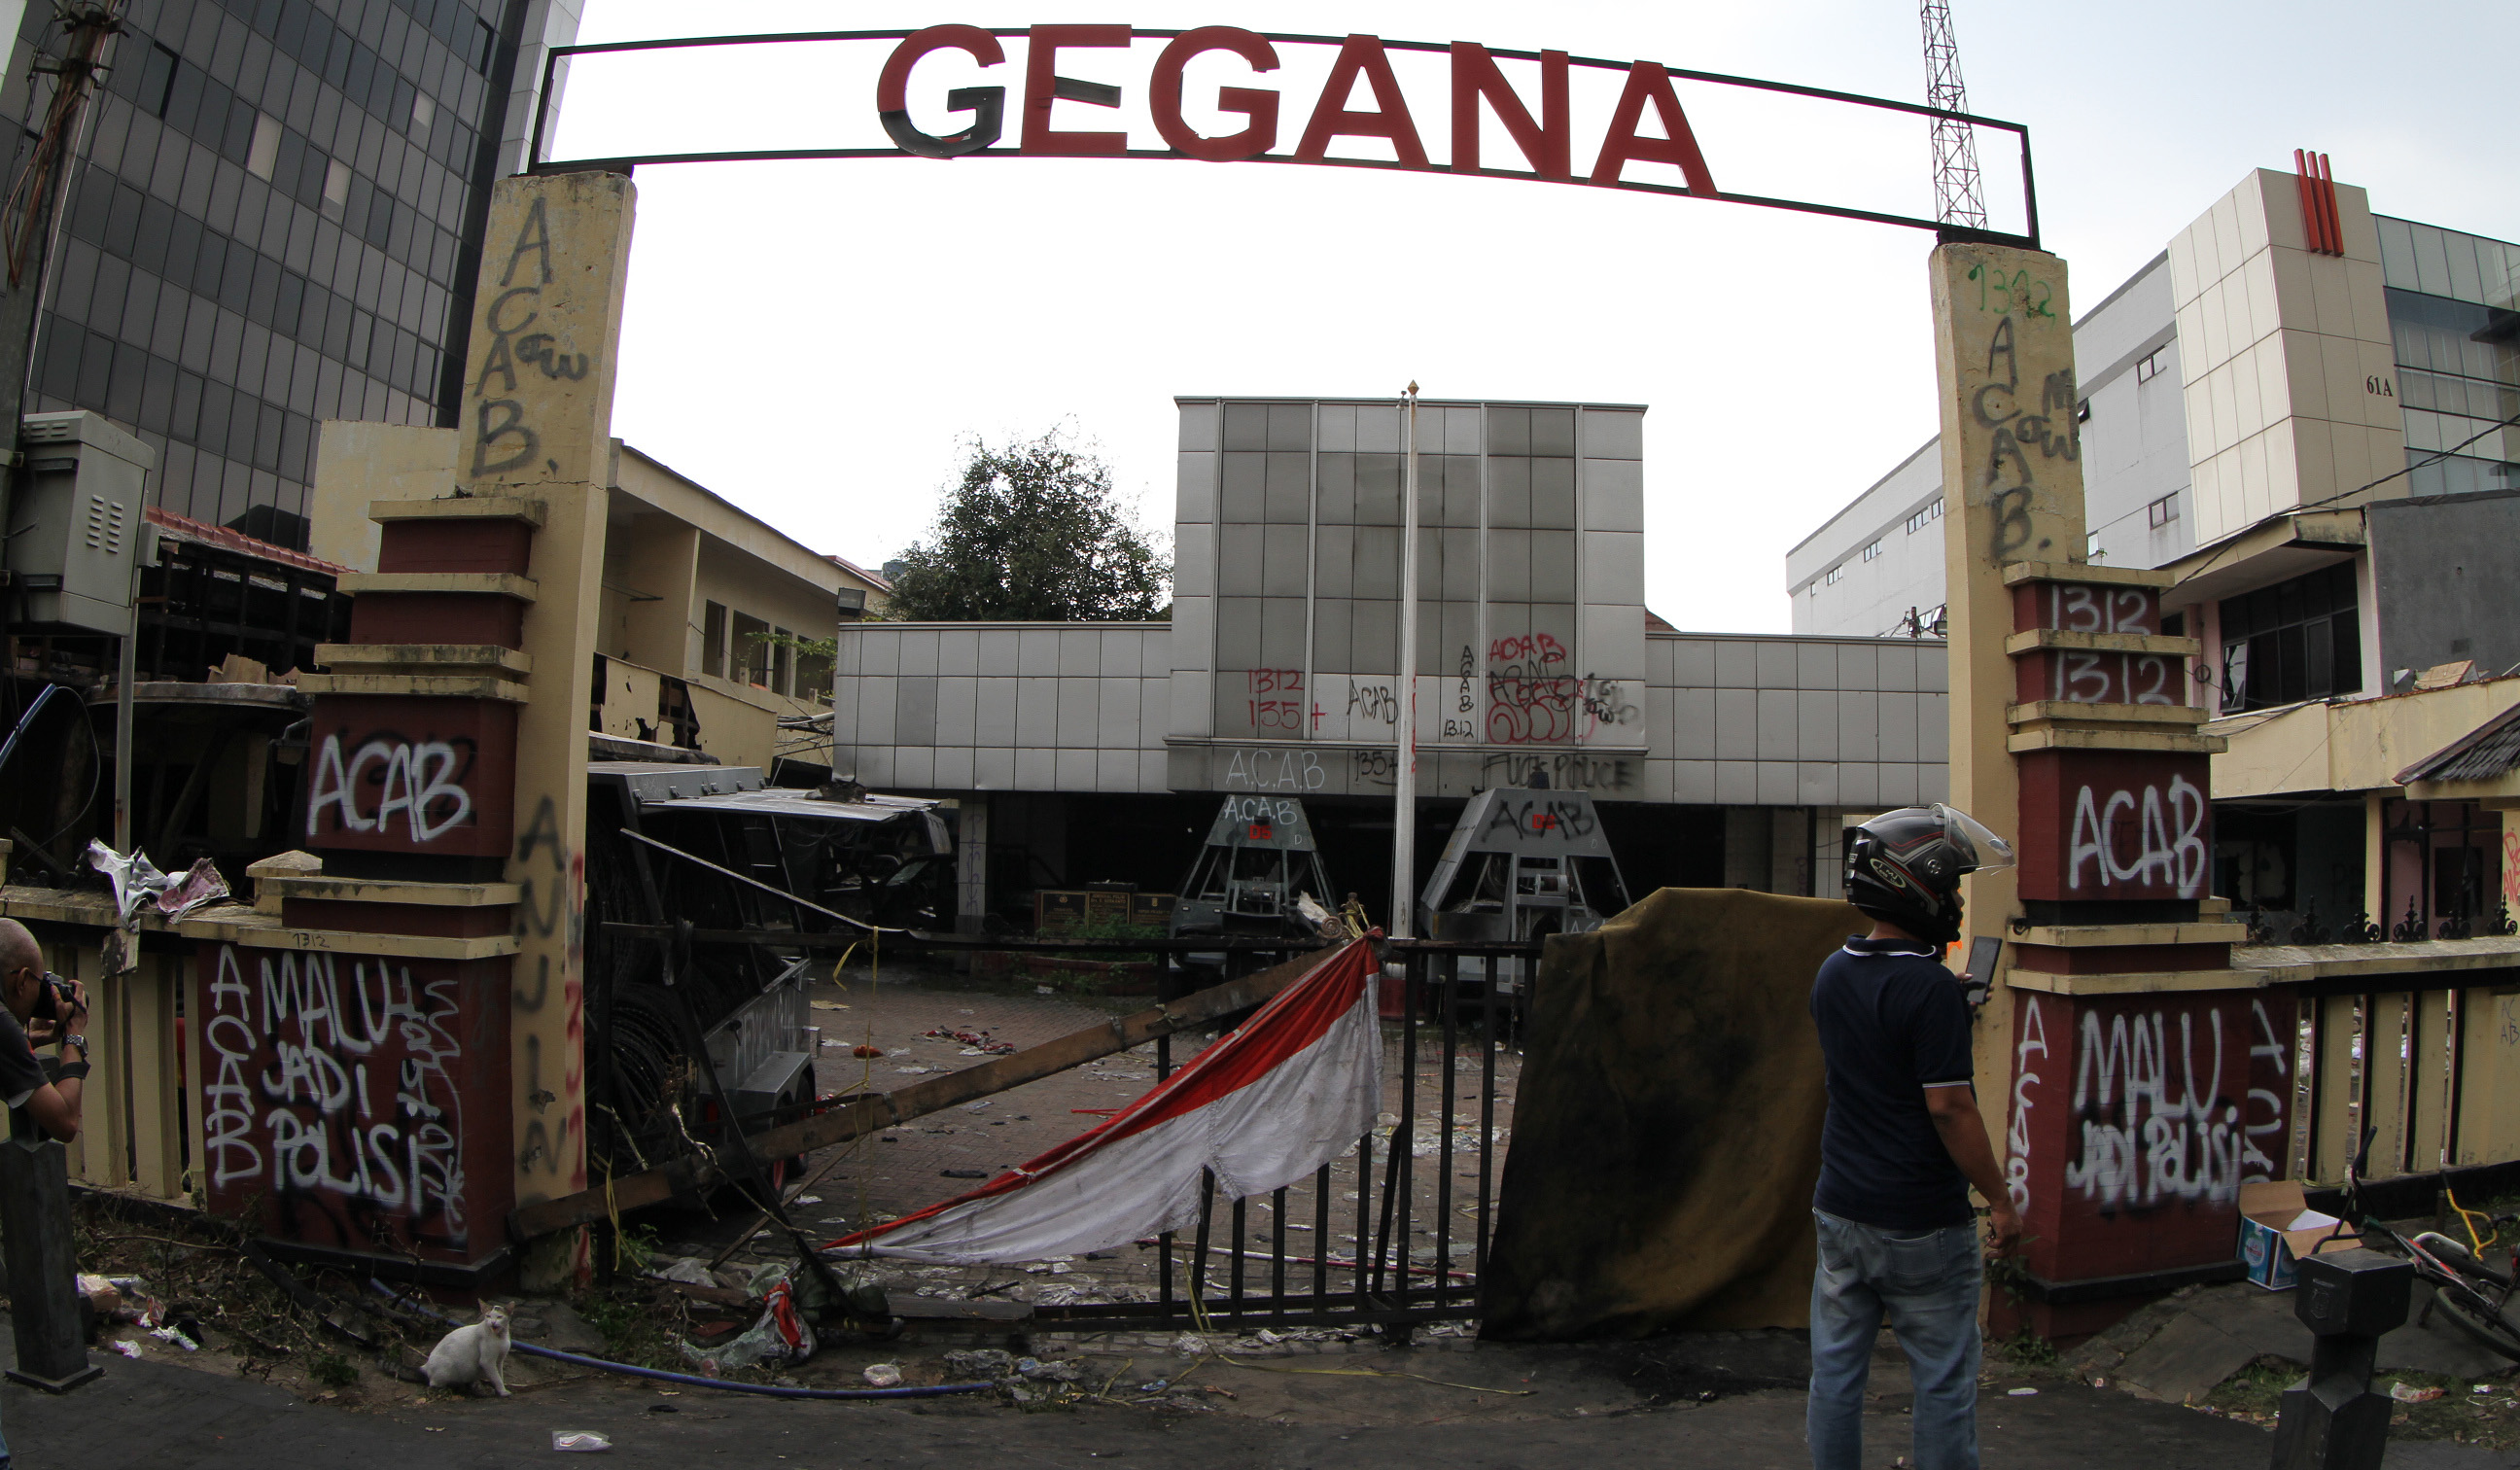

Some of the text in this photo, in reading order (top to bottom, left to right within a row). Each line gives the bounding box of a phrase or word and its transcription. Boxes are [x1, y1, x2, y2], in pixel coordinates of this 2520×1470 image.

[877, 23, 1719, 197] GEGANA
[1969, 264, 2055, 327] 1312
[2365, 374, 2395, 398] 61A
[2051, 583, 2152, 635] 1312
[1248, 669, 1305, 693] 1312
[1348, 679, 1399, 724] ACAB
[2055, 650, 2172, 706] 1312
[306, 733, 472, 844] ACAB
[1481, 799, 1595, 842] ACAB
[2068, 772, 2205, 901] ACAB
[293, 933, 331, 949] 1312
[260, 950, 392, 1055] MALU
[204, 943, 262, 1190] ACAB
[261, 1038, 375, 1120] JADI
[2073, 1007, 2223, 1127] MALU
[265, 1108, 424, 1220] POLISI
